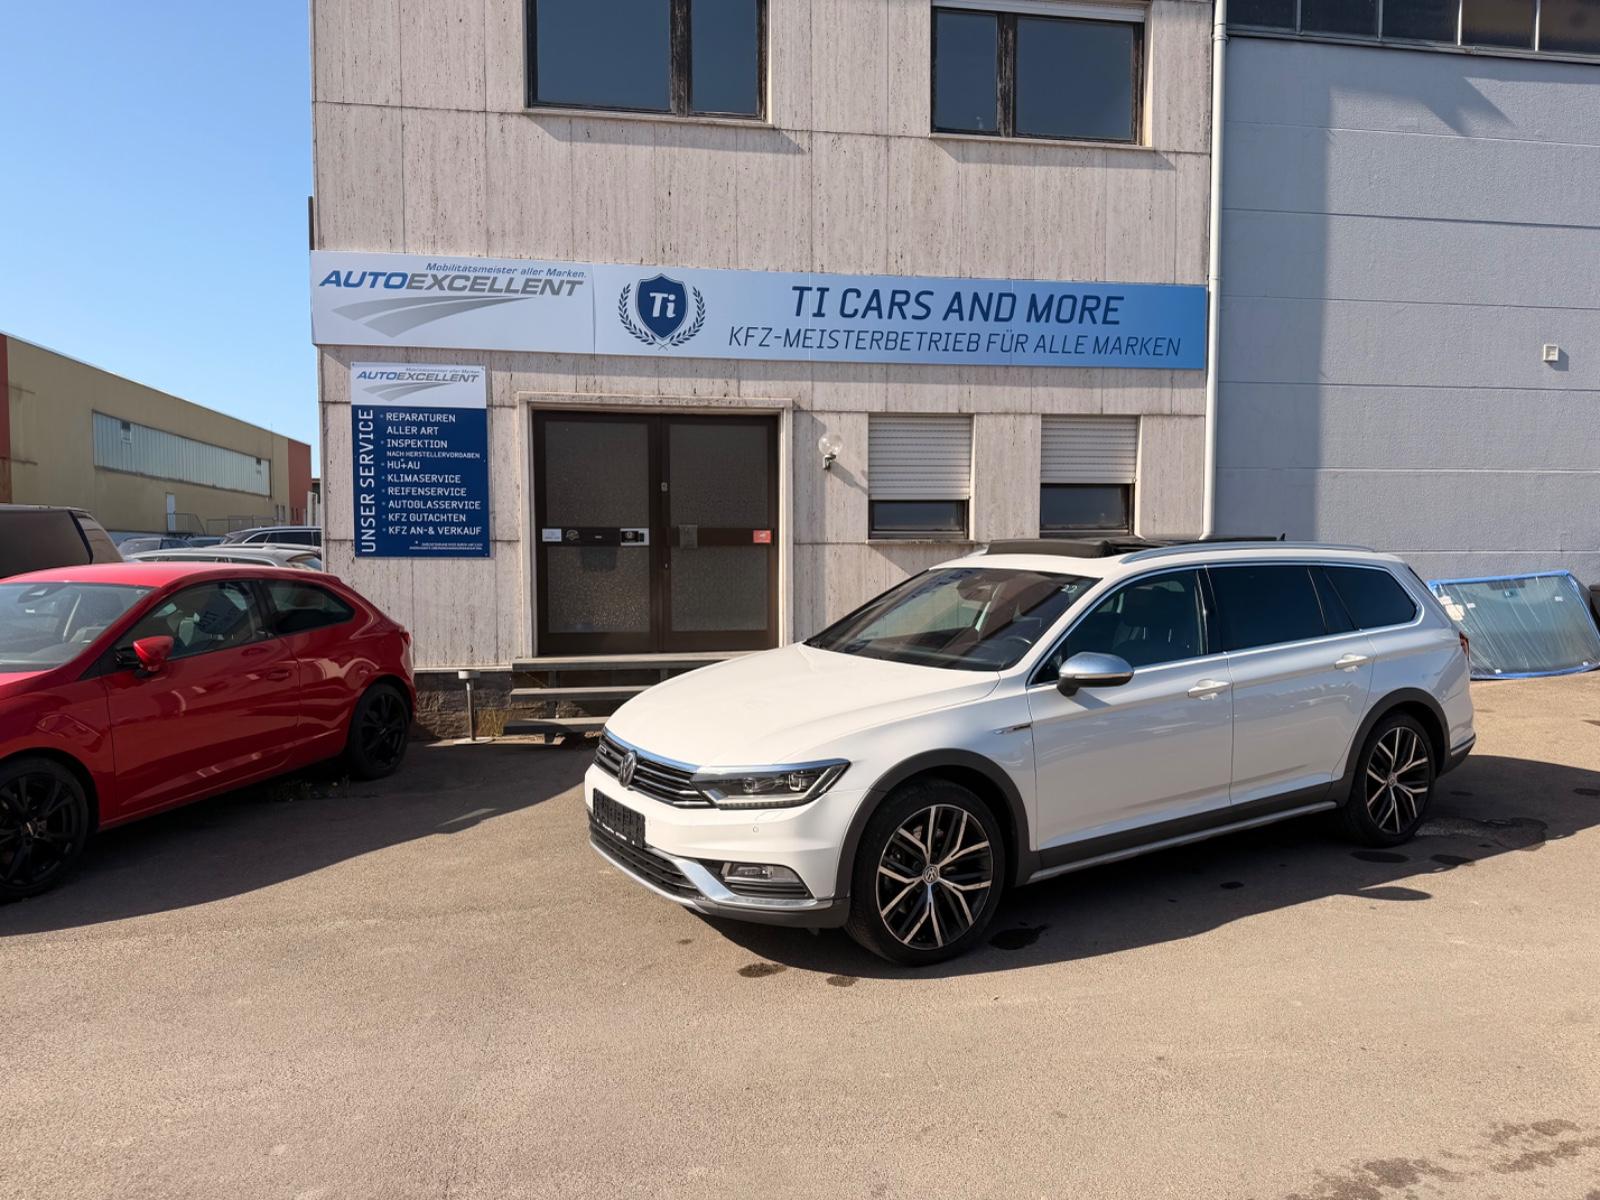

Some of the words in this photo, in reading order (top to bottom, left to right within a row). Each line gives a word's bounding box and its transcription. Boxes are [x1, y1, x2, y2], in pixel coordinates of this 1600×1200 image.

[520, 268, 543, 276] aller
[318, 270, 584, 296] AUTOEXCELLENT
[649, 292, 677, 318] Ti
[792, 286, 830, 317] TI
[839, 287, 934, 320] CARS
[942, 291, 1017, 322] AND
[1025, 293, 1125, 325] MORE
[728, 326, 981, 353] KFZ-MEISTERBETRIEB
[986, 329, 1029, 353] FÜR
[1033, 334, 1088, 355] ALLE
[1091, 335, 1181, 356] MARKEN
[357, 371, 479, 383] AUTOEXCELLENT
[386, 412, 456, 423] REPARATUREN
[386, 426, 417, 435] ALLER
[420, 426, 439, 435] ART
[358, 409, 375, 488] SERVICE
[387, 439, 448, 448] INSPEKTION
[387, 460, 420, 470] HU+AU
[387, 474, 461, 484] KLIMASERVICE
[388, 487, 467, 497] REIFENSERVICE
[388, 500, 481, 510] AUTOGLASSERVICE
[388, 513, 407, 522] KFZ
[409, 513, 466, 522] GUTACHTEN
[360, 493, 376, 553] UNSER
[388, 526, 407, 535] KFZ
[437, 526, 482, 536] VERKAUF
